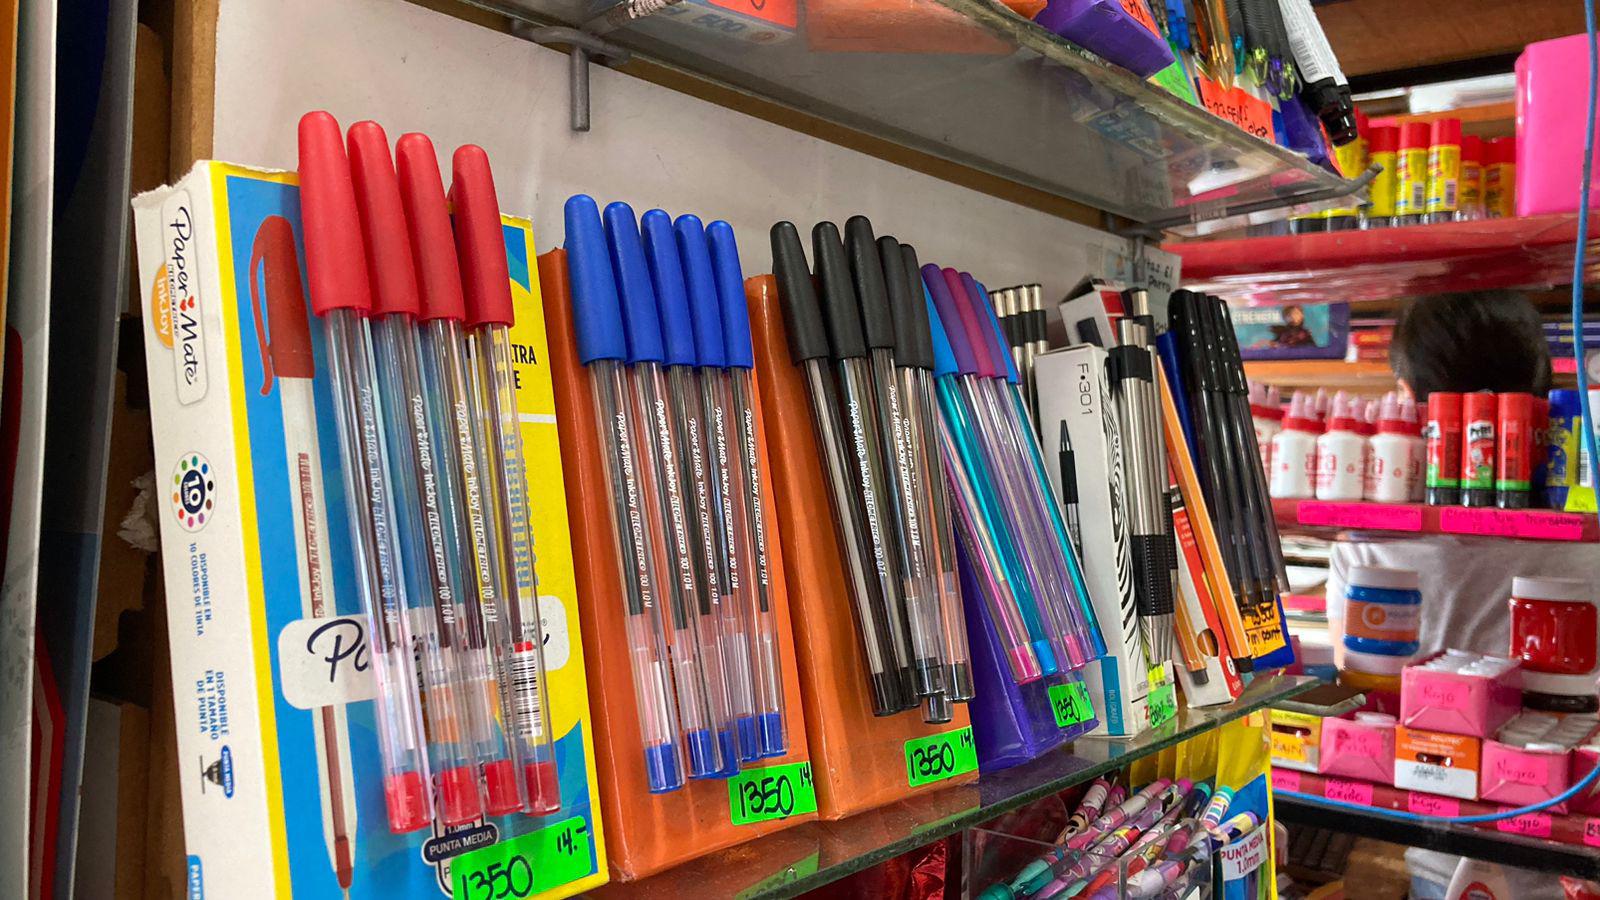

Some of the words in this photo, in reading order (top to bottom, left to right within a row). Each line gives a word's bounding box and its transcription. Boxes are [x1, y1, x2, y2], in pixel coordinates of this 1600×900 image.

[167, 205, 197, 297] Paper
[155, 277, 170, 335] InkJoy
[179, 311, 202, 385] Mate
[410, 394, 426, 431] Paper
[615, 411, 627, 441] Paper
[713, 406, 724, 437] Paper
[742, 408, 754, 437] Paper
[848, 400, 861, 430] Paper
[687, 417, 698, 447] Paper
[854, 433, 866, 458] Mate
[418, 439, 432, 470] Mate
[461, 441, 475, 473] Mate
[660, 433, 672, 460] Mate
[717, 439, 727, 465] Mate
[746, 441, 757, 465] Mate
[896, 439, 906, 464] InkJoy
[620, 447, 632, 475] Mate
[692, 453, 703, 478] Mate
[858, 460, 871, 488] InkJoy
[187, 475, 202, 508] 10
[368, 467, 382, 503] InkJoy
[421, 473, 437, 508] InkJoy
[664, 464, 677, 492] InkJoy
[719, 468, 730, 496] InkJoy
[749, 468, 759, 494] InkJoy
[465, 476, 480, 511] InkJoy
[625, 478, 637, 508] InkJoy
[696, 481, 707, 509] InkJoy
[188, 542, 196, 552] 10
[189, 554, 201, 592] COLORES
[680, 556, 689, 569] 100
[729, 556, 737, 568] 100
[196, 553, 212, 606] DISPONIBLE
[481, 585, 493, 598] 100
[639, 573, 648, 586] 100
[708, 571, 716, 584] 100
[193, 595, 202, 607] DE
[438, 585, 450, 599] 100
[194, 609, 204, 636] TINTA
[203, 608, 213, 620] EN
[196, 679, 204, 694] DE
[205, 669, 214, 683] EN
[196, 697, 209, 732] PUNTA
[215, 671, 229, 735] DISPONIBLE
[206, 695, 221, 740] TAMAÑO
[909, 741, 955, 780] 1350
[738, 775, 795, 819] 1350
[428, 838, 462, 856] PUNTA
[461, 829, 493, 846] MEDIA
[1221, 843, 1248, 860] PUNTA
[462, 855, 534, 900] 1350
